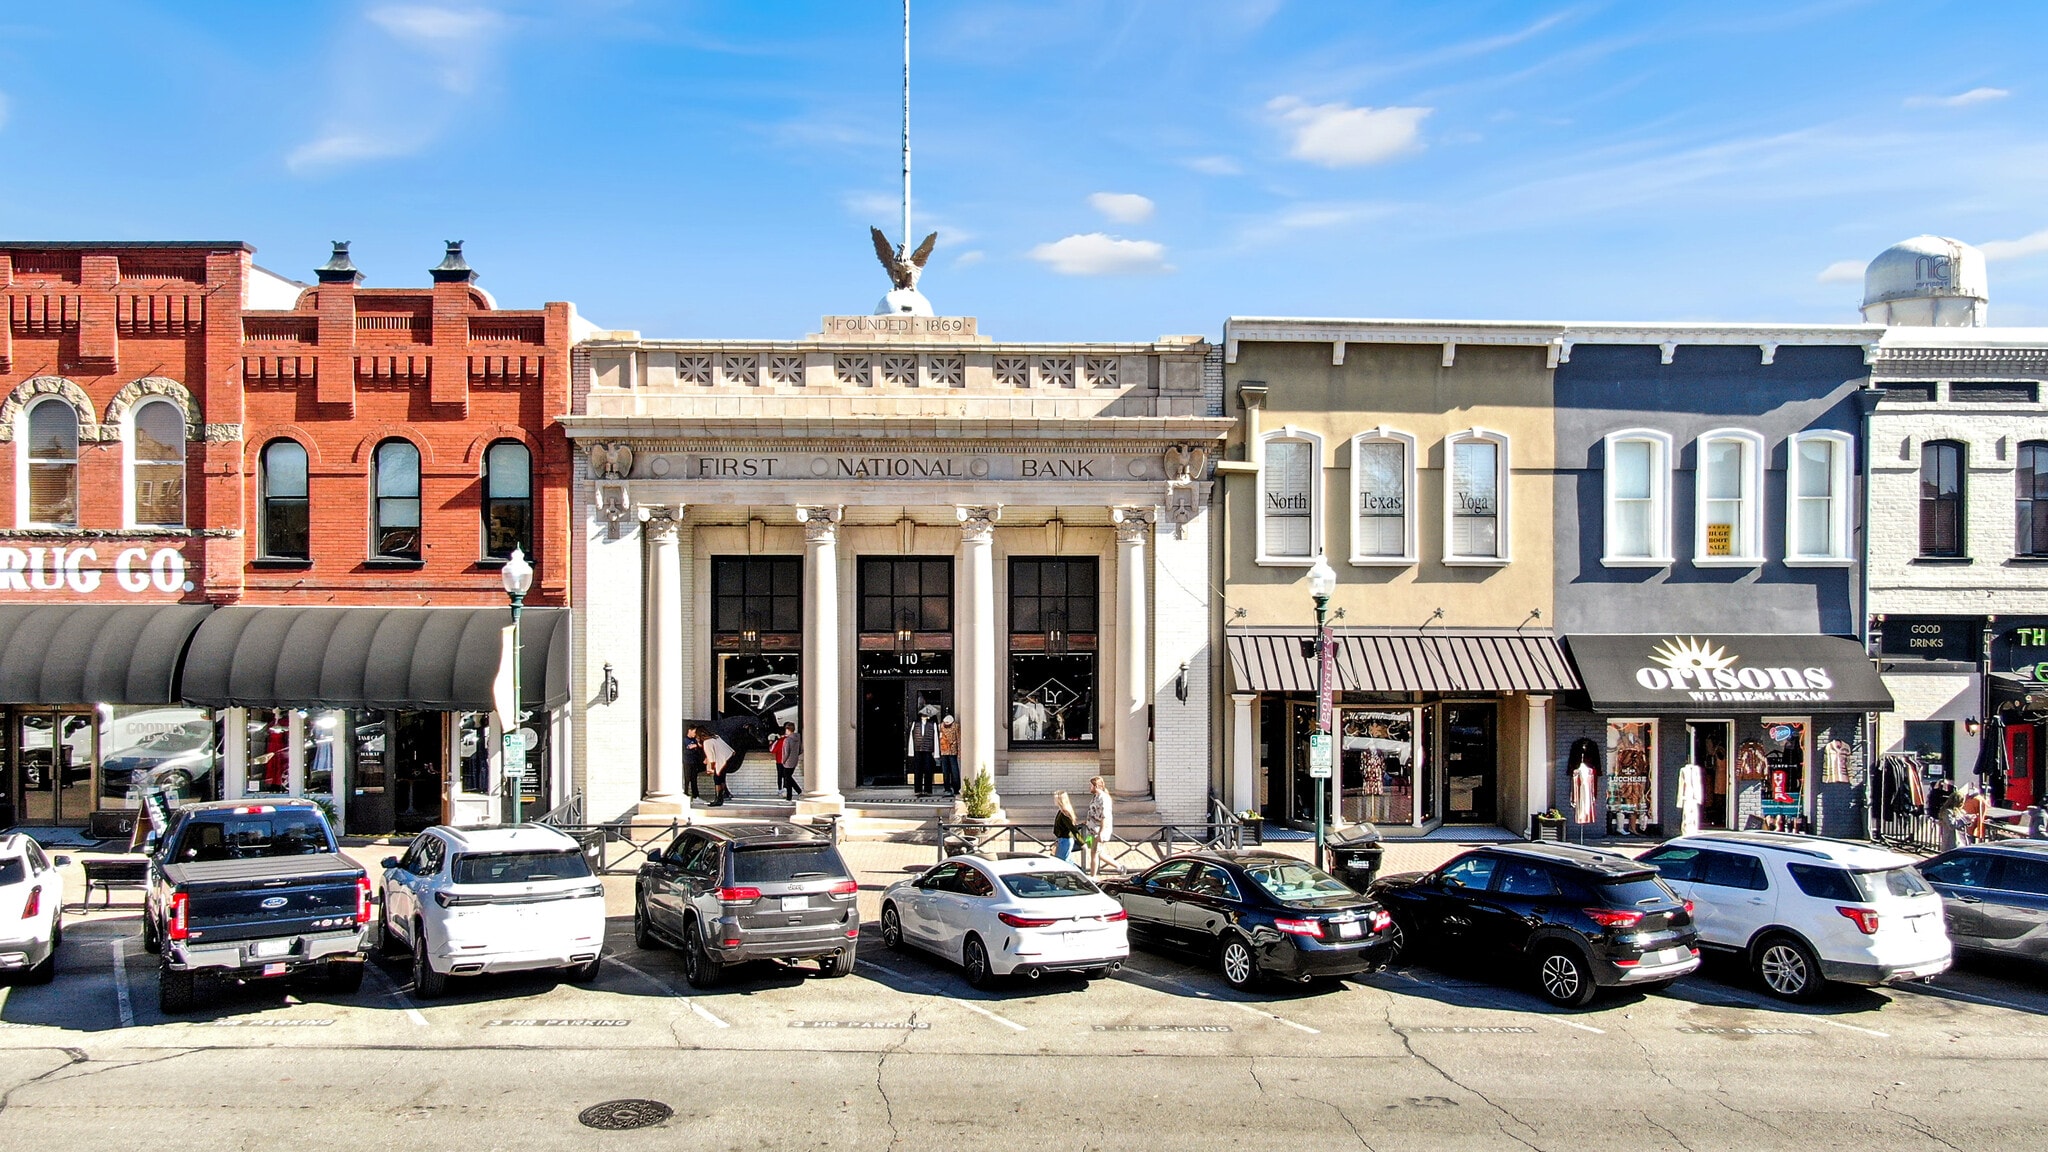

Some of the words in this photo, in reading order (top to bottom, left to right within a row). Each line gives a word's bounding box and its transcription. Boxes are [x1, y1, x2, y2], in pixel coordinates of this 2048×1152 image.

[836, 319, 908, 331] FOUNDED
[926, 319, 962, 332] 1869
[699, 458, 779, 476] FIRST
[837, 458, 963, 477] NATIONAL
[1021, 459, 1094, 477] BANK
[1267, 492, 1307, 510] North
[1360, 491, 1401, 510] Texas
[1458, 491, 1489, 514] Yoga
[1911, 624, 1941, 634] GOOD
[1909, 638, 1944, 648] DRINKS
[1636, 667, 1832, 690] orisons
[1688, 691, 1718, 701] WE
[1719, 691, 1775, 701] DRESS
[1775, 691, 1829, 701] TEXAS
[1773, 773, 1787, 800] HYER
[848, 1021, 930, 1029] PARKING
